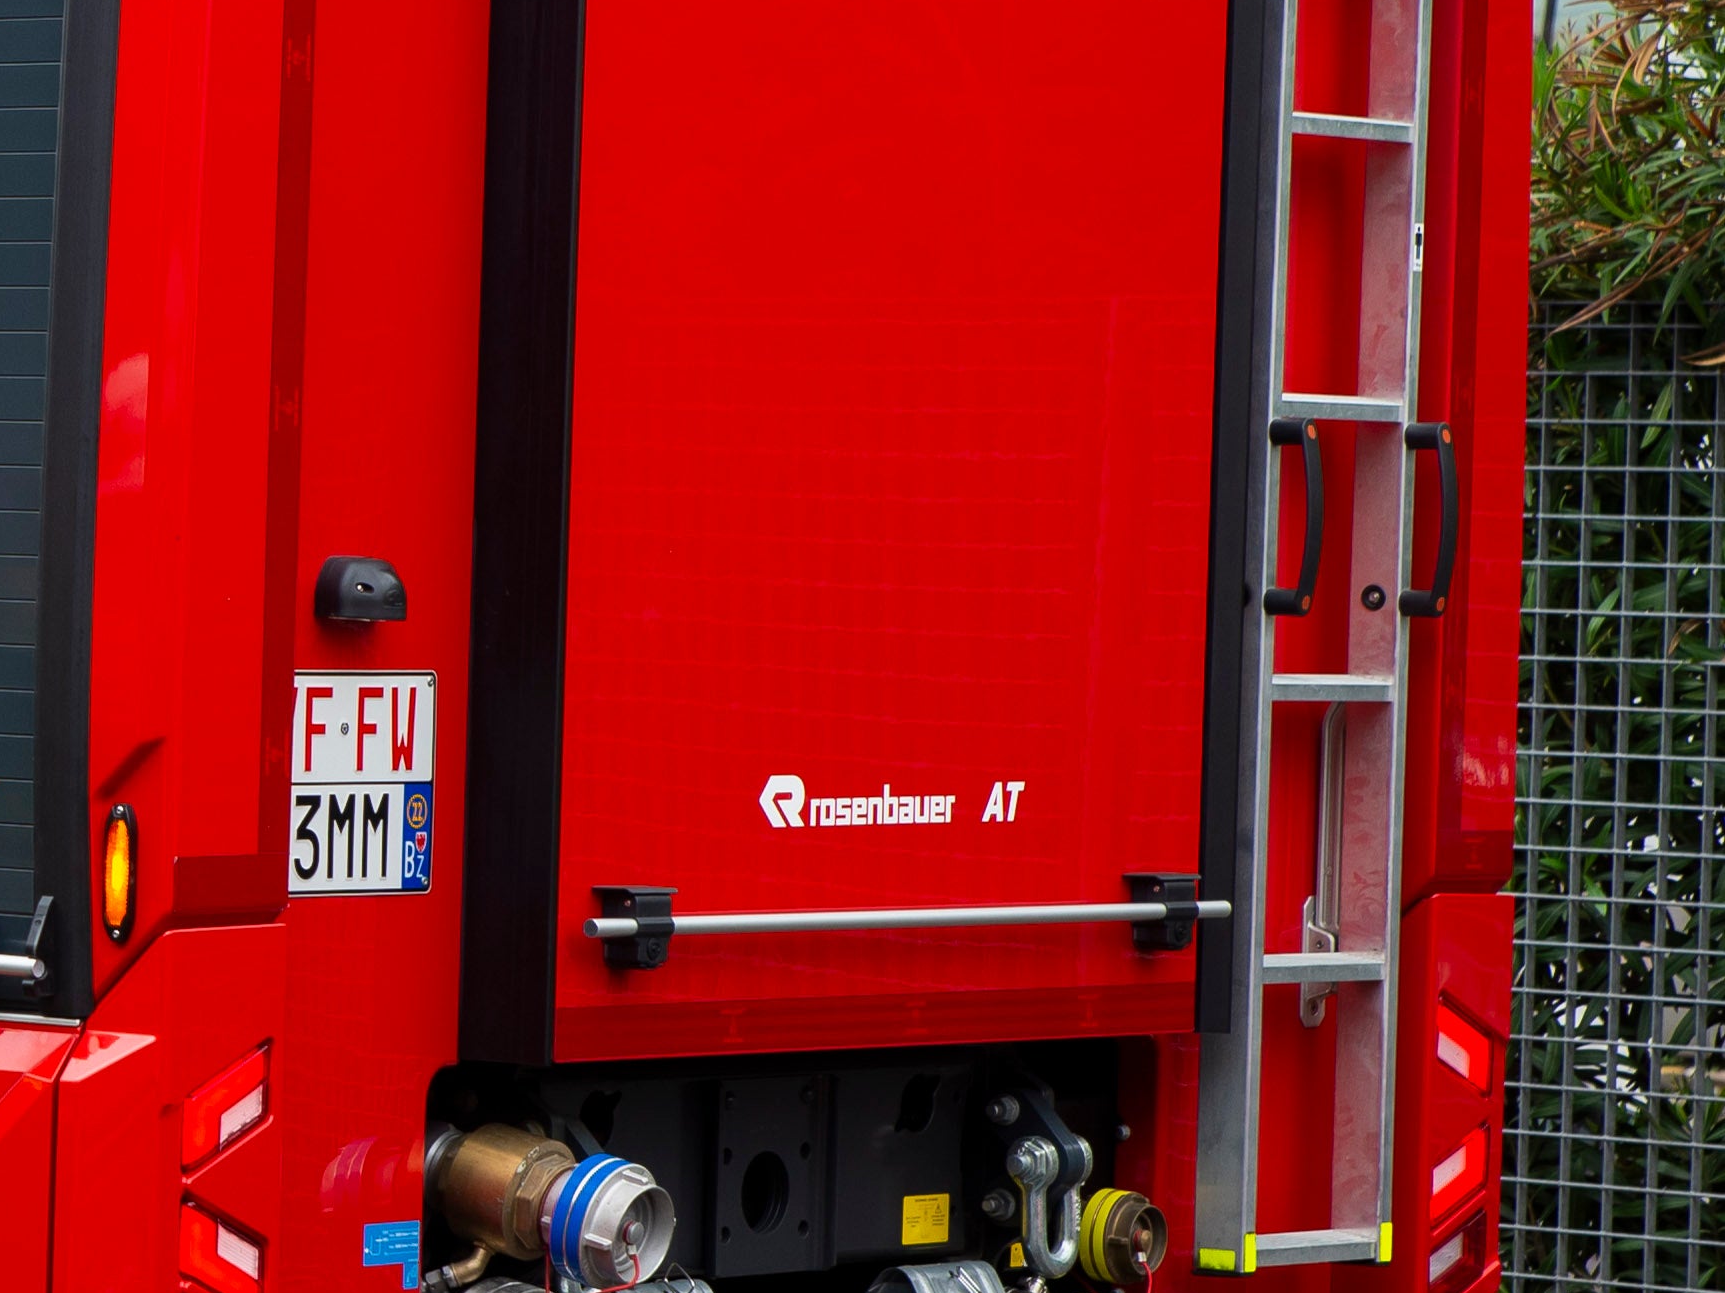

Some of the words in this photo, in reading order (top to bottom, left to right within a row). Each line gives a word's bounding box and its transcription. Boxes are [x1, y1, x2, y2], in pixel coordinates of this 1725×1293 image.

[294, 687, 333, 772] F
[355, 687, 417, 772] FW
[412, 801, 423, 822] 22
[810, 783, 955, 826] rosenbauer
[981, 782, 1024, 823] AT
[293, 794, 390, 880] 3MM
